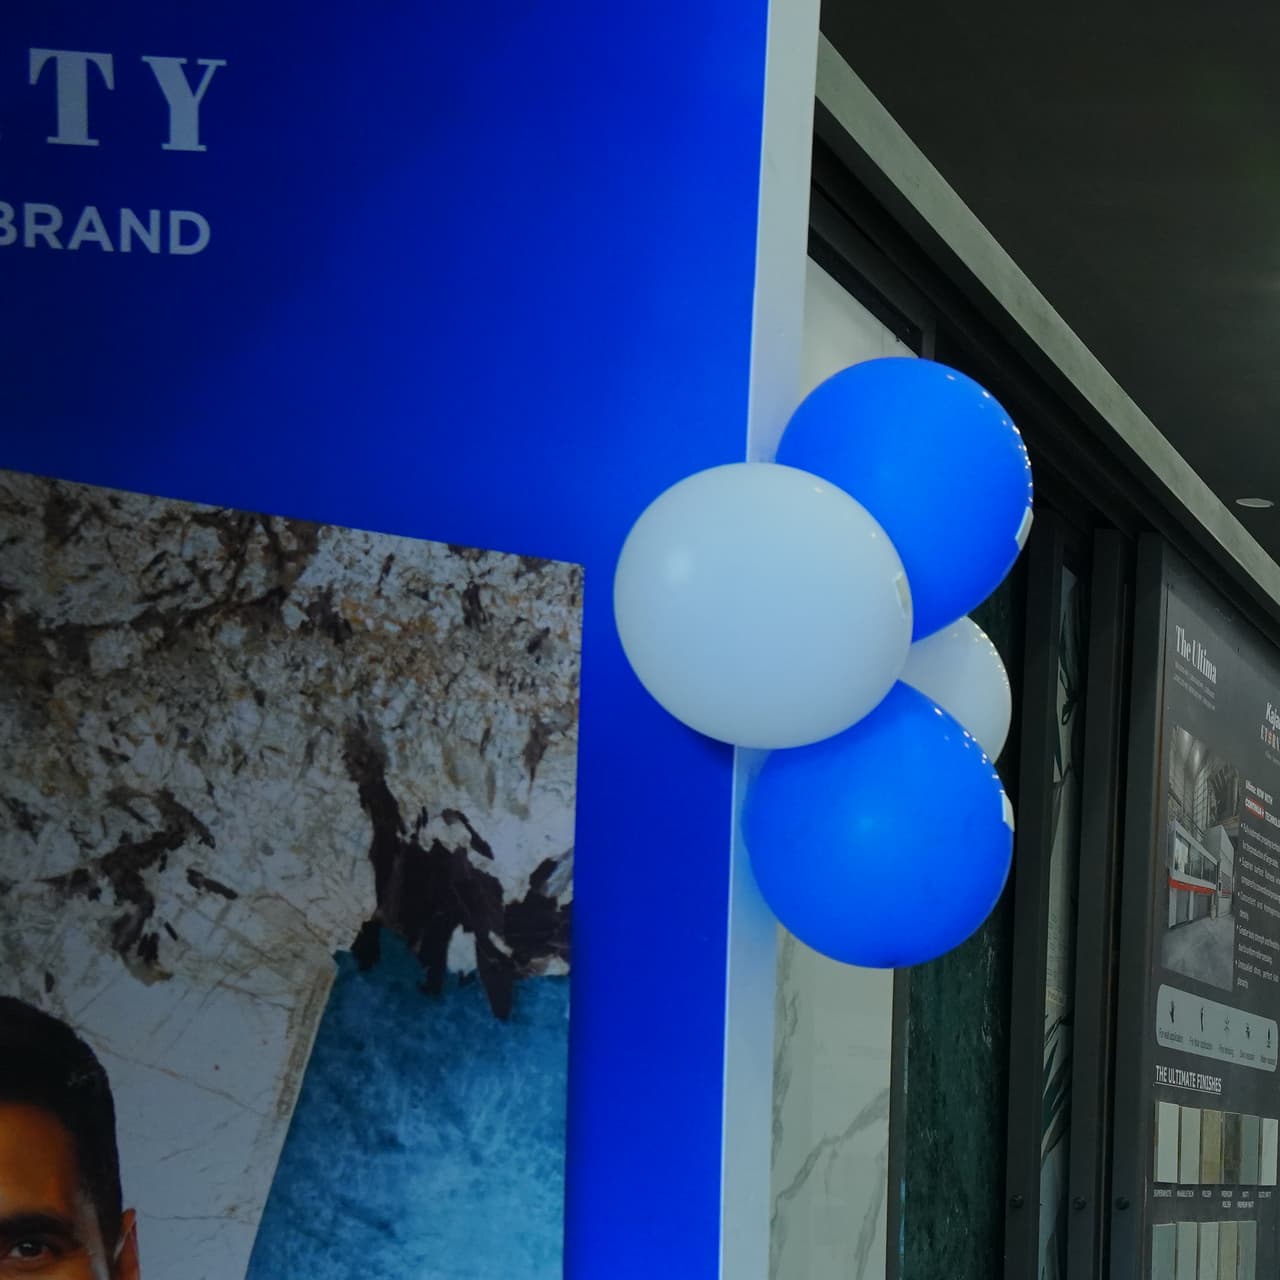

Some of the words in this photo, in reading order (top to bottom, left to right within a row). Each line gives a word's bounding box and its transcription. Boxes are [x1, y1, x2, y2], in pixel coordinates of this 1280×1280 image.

[1175, 624, 1191, 662] The
[1192, 639, 1217, 685] Ultima
[1156, 1064, 1167, 1083] THE
[1168, 1067, 1196, 1088] ULTIMATE
[1196, 1073, 1222, 1093] FINISHES
